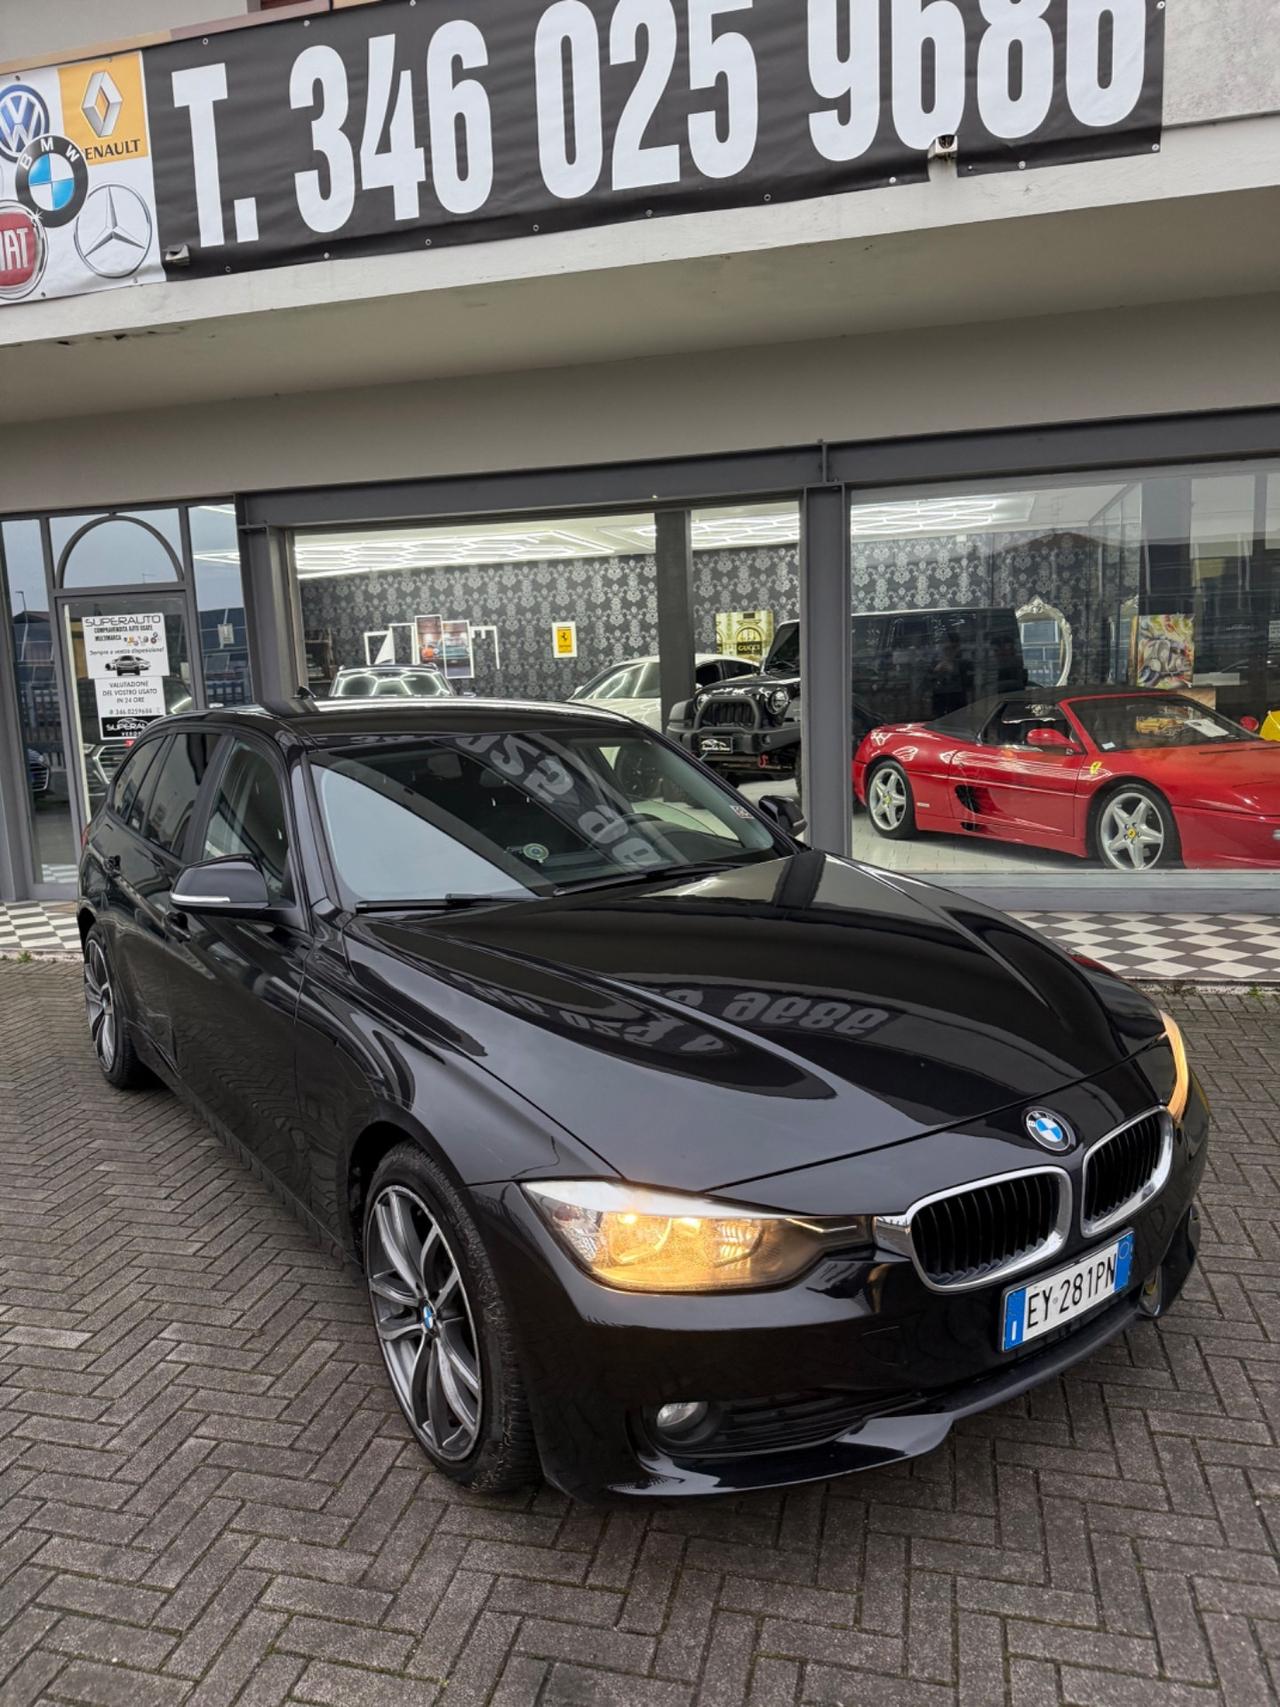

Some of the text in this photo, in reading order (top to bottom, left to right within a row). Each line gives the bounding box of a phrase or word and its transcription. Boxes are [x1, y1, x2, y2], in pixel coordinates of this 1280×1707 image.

[171, 62, 260, 248] T.
[289, 19, 494, 233] 346
[534, 0, 759, 200] 025
[20, 137, 81, 171] BMW
[85, 138, 141, 161] ENAULT
[0, 227, 29, 272] IAT
[84, 614, 161, 628] SUPERAUTO
[109, 680, 149, 688] VALUTAZIONE
[1027, 1253, 1117, 1329] EY 281PN
